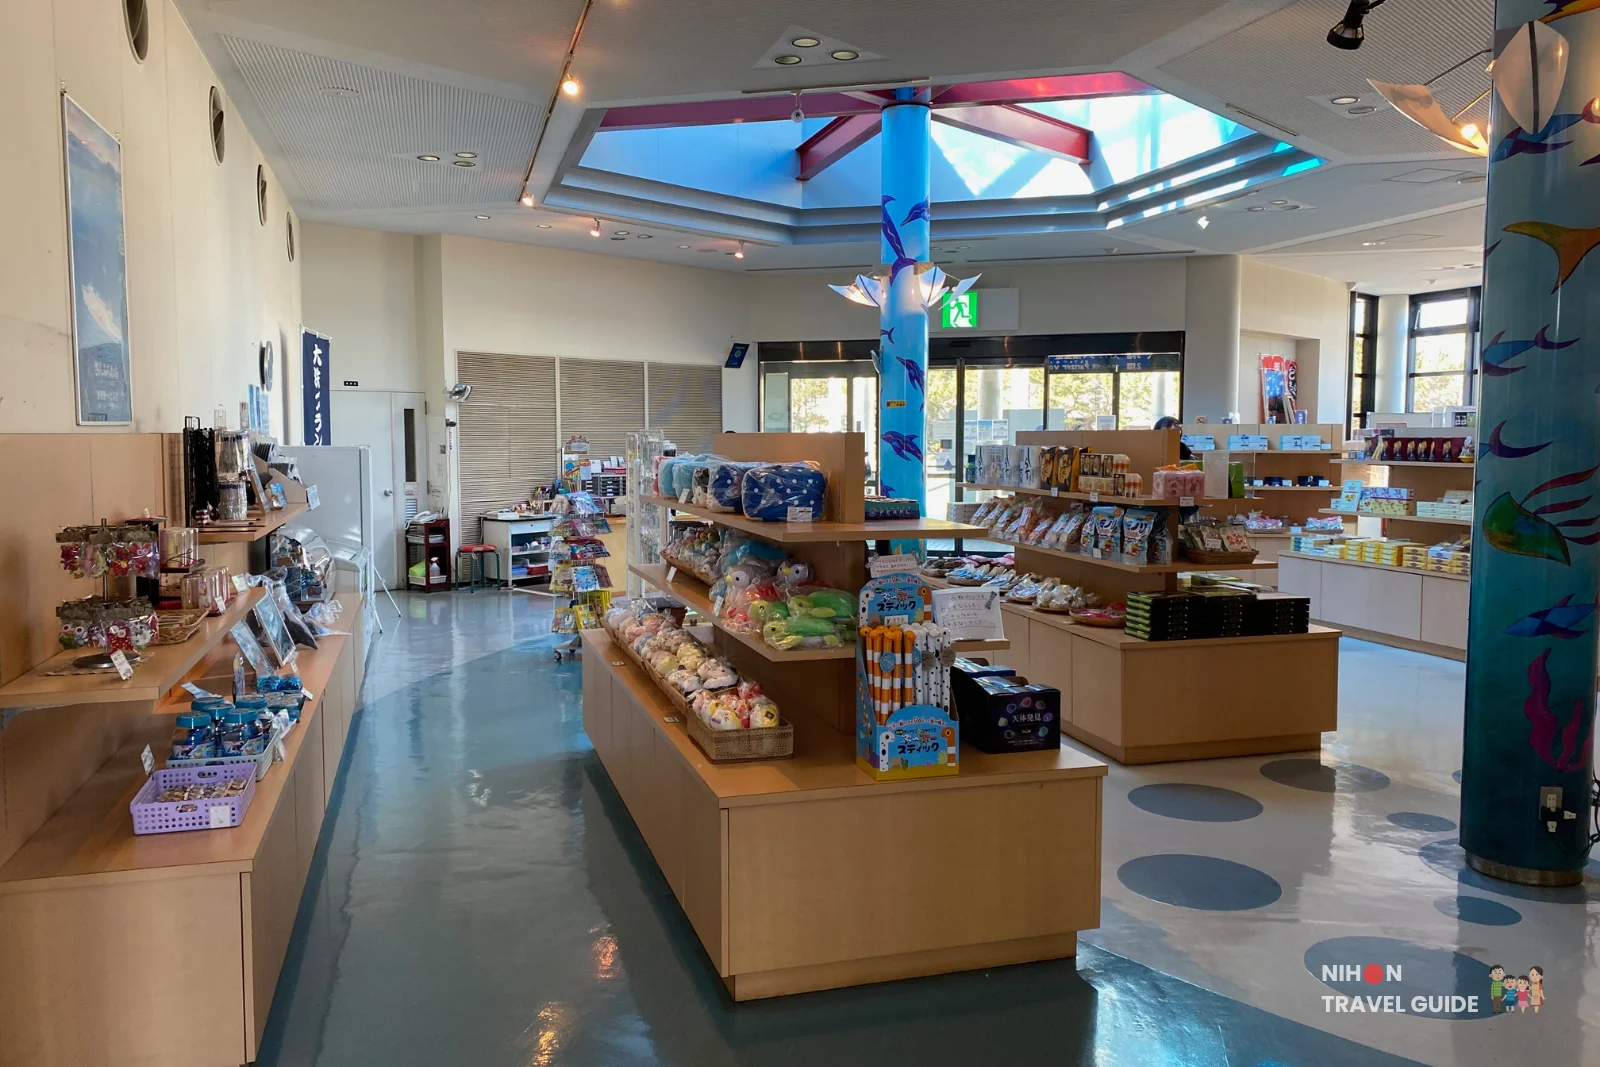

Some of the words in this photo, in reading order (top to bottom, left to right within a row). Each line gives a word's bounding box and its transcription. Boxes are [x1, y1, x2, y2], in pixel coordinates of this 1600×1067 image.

[876, 600, 917, 612] スティック
[1012, 712, 1042, 723] 天体発見
[897, 742, 939, 755] スティック
